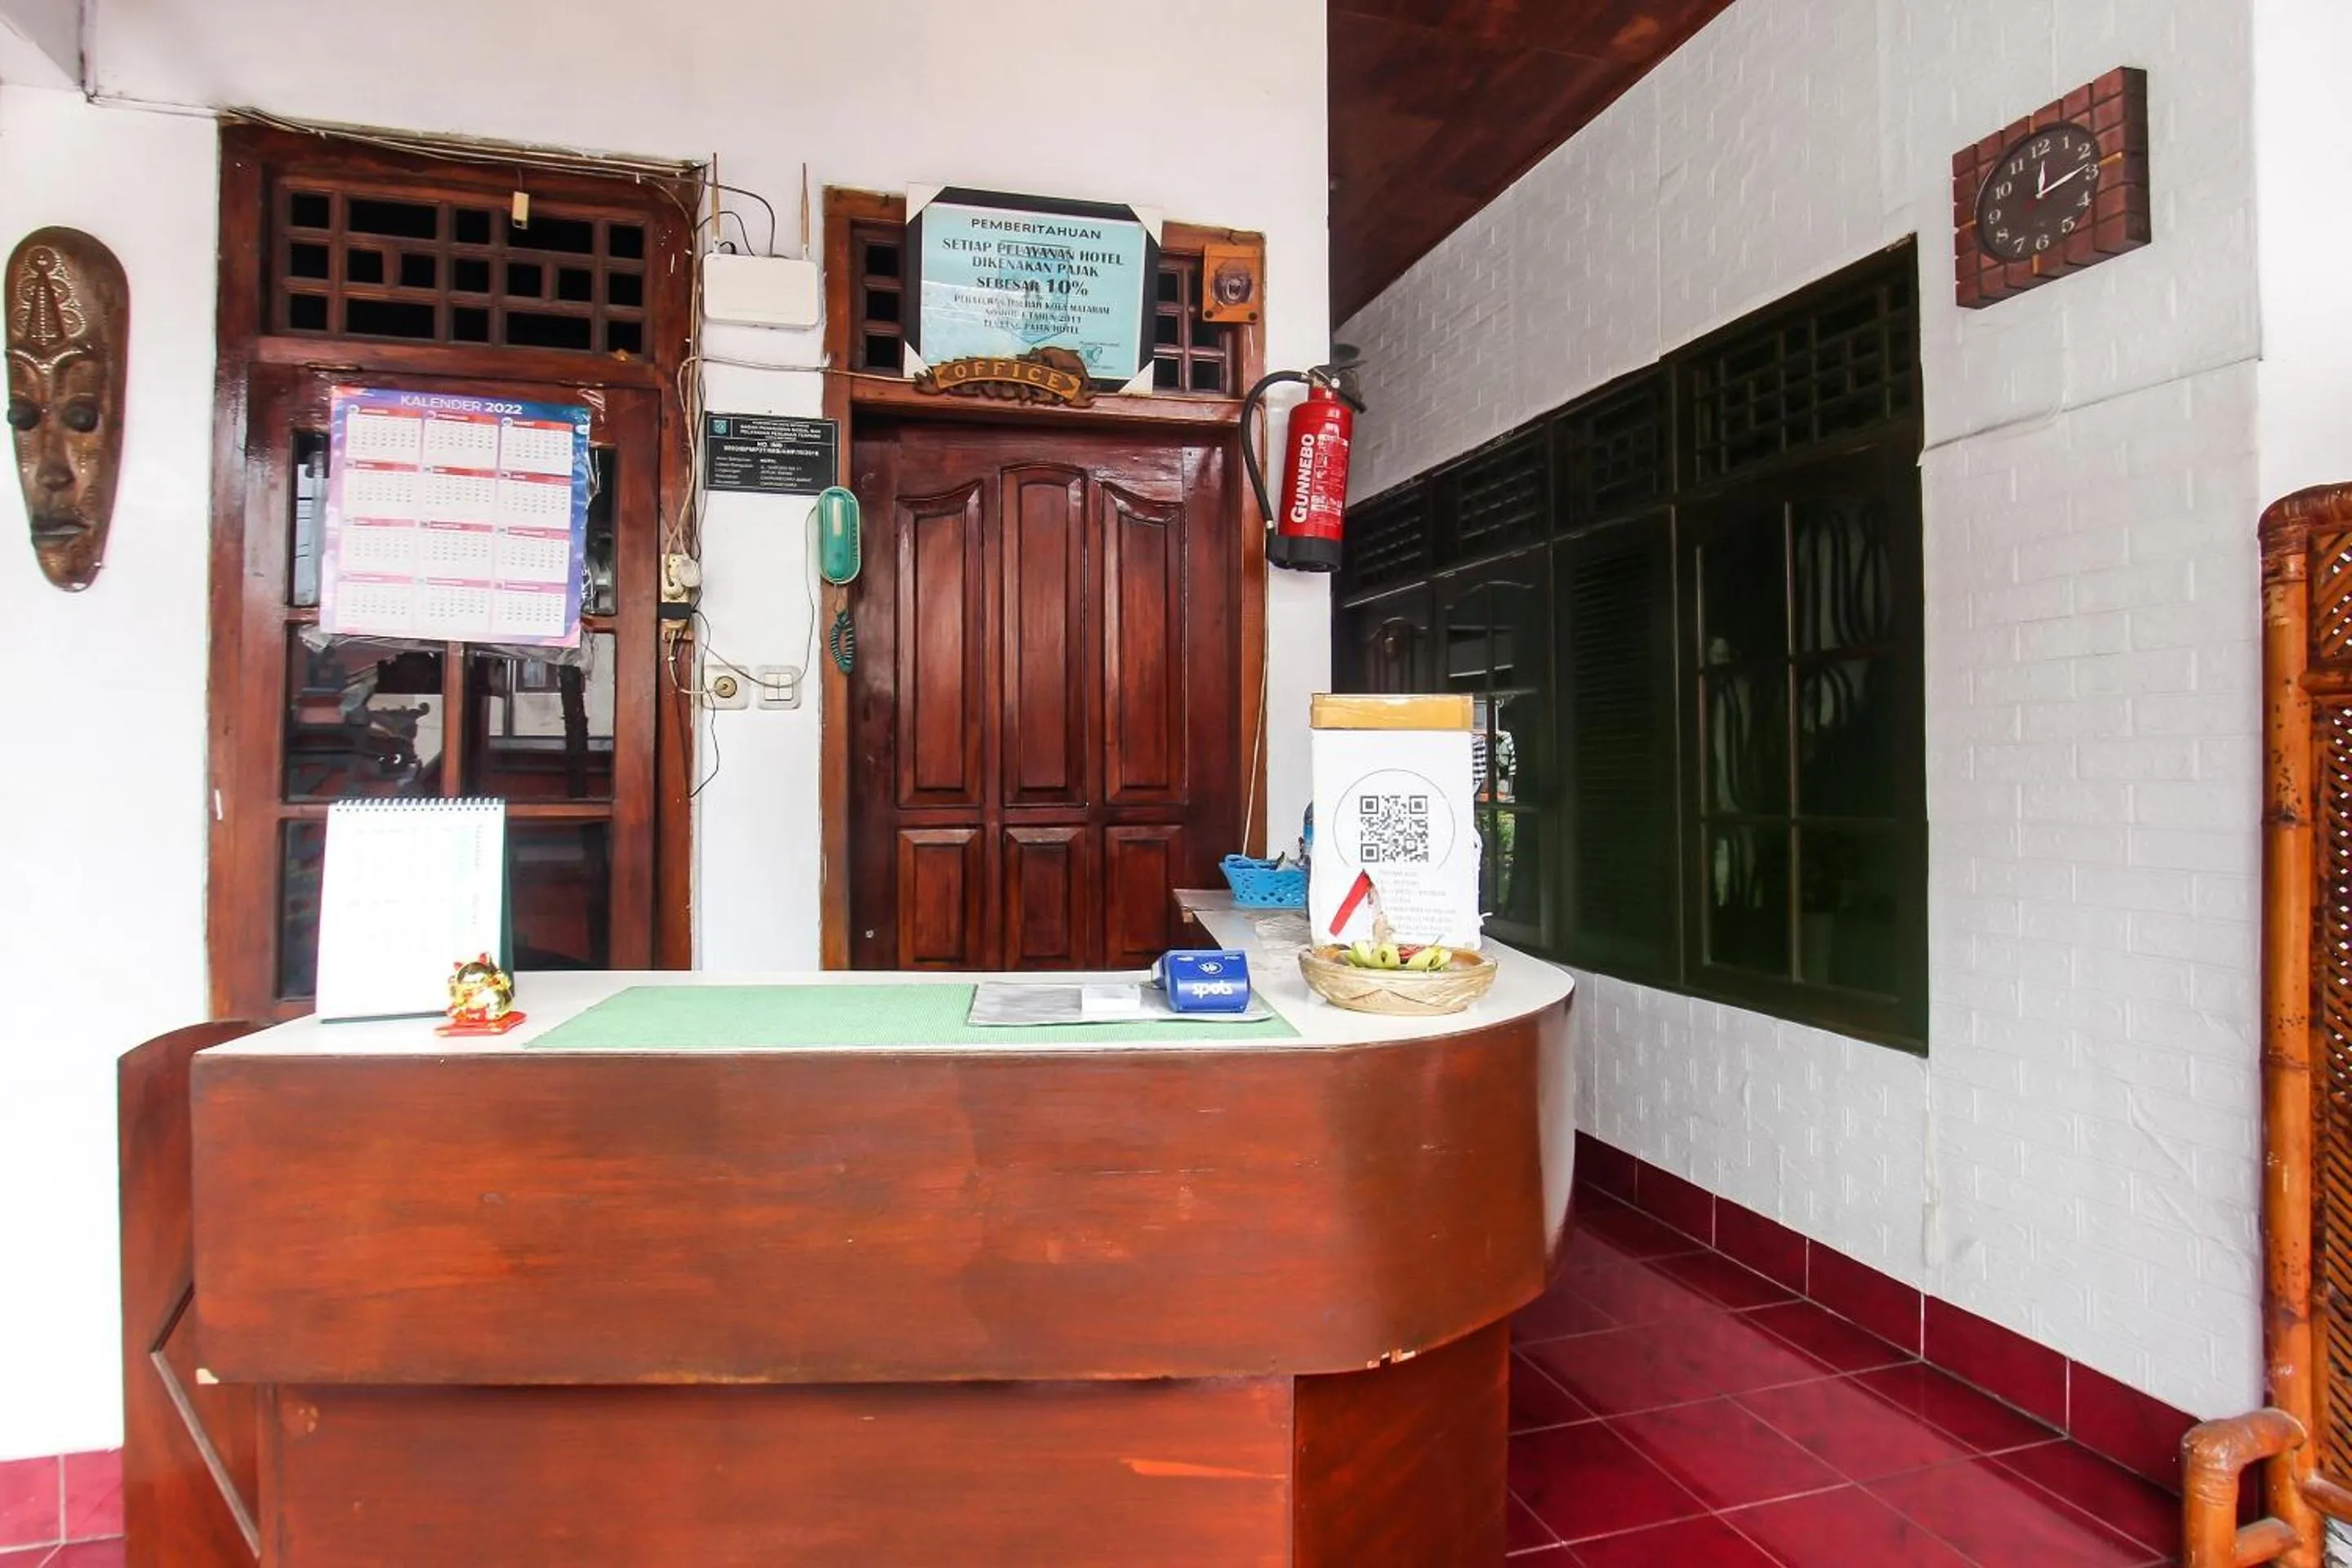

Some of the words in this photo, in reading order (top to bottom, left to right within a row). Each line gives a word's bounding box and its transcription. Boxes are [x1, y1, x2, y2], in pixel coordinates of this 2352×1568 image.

[2030, 139, 2051, 158] 12
[2062, 136, 2069, 150] 1
[2077, 143, 2091, 160] 2
[2009, 158, 2024, 175] 11
[2084, 163, 2099, 181] 3
[1995, 182, 2012, 200] 10
[2077, 190, 2092, 207] 4
[1989, 210, 2002, 225] 9
[2060, 216, 2075, 234] 5
[971, 218, 1102, 240] PEMBERITAHUAN
[1995, 228, 2009, 243] 8
[942, 238, 992, 253] SETIAP
[997, 243, 1075, 261] PELAYANAN
[1080, 250, 1125, 265] HOTEL
[2013, 237, 2025, 253] 7
[2035, 234, 2050, 251] 6
[972, 256, 1052, 274] DIKENAKAN
[1058, 262, 1099, 278] PAJAK
[977, 276, 1040, 293] SEBESAR
[1047, 278, 1089, 297] 10%
[1070, 304, 1111, 315] MATARAM
[954, 362, 1060, 388] OFFICE
[400, 394, 482, 412] KALENDER
[485, 402, 523, 415] 2022
[1290, 433, 1315, 523] GUNNEBO
[1192, 980, 1233, 999] spots
